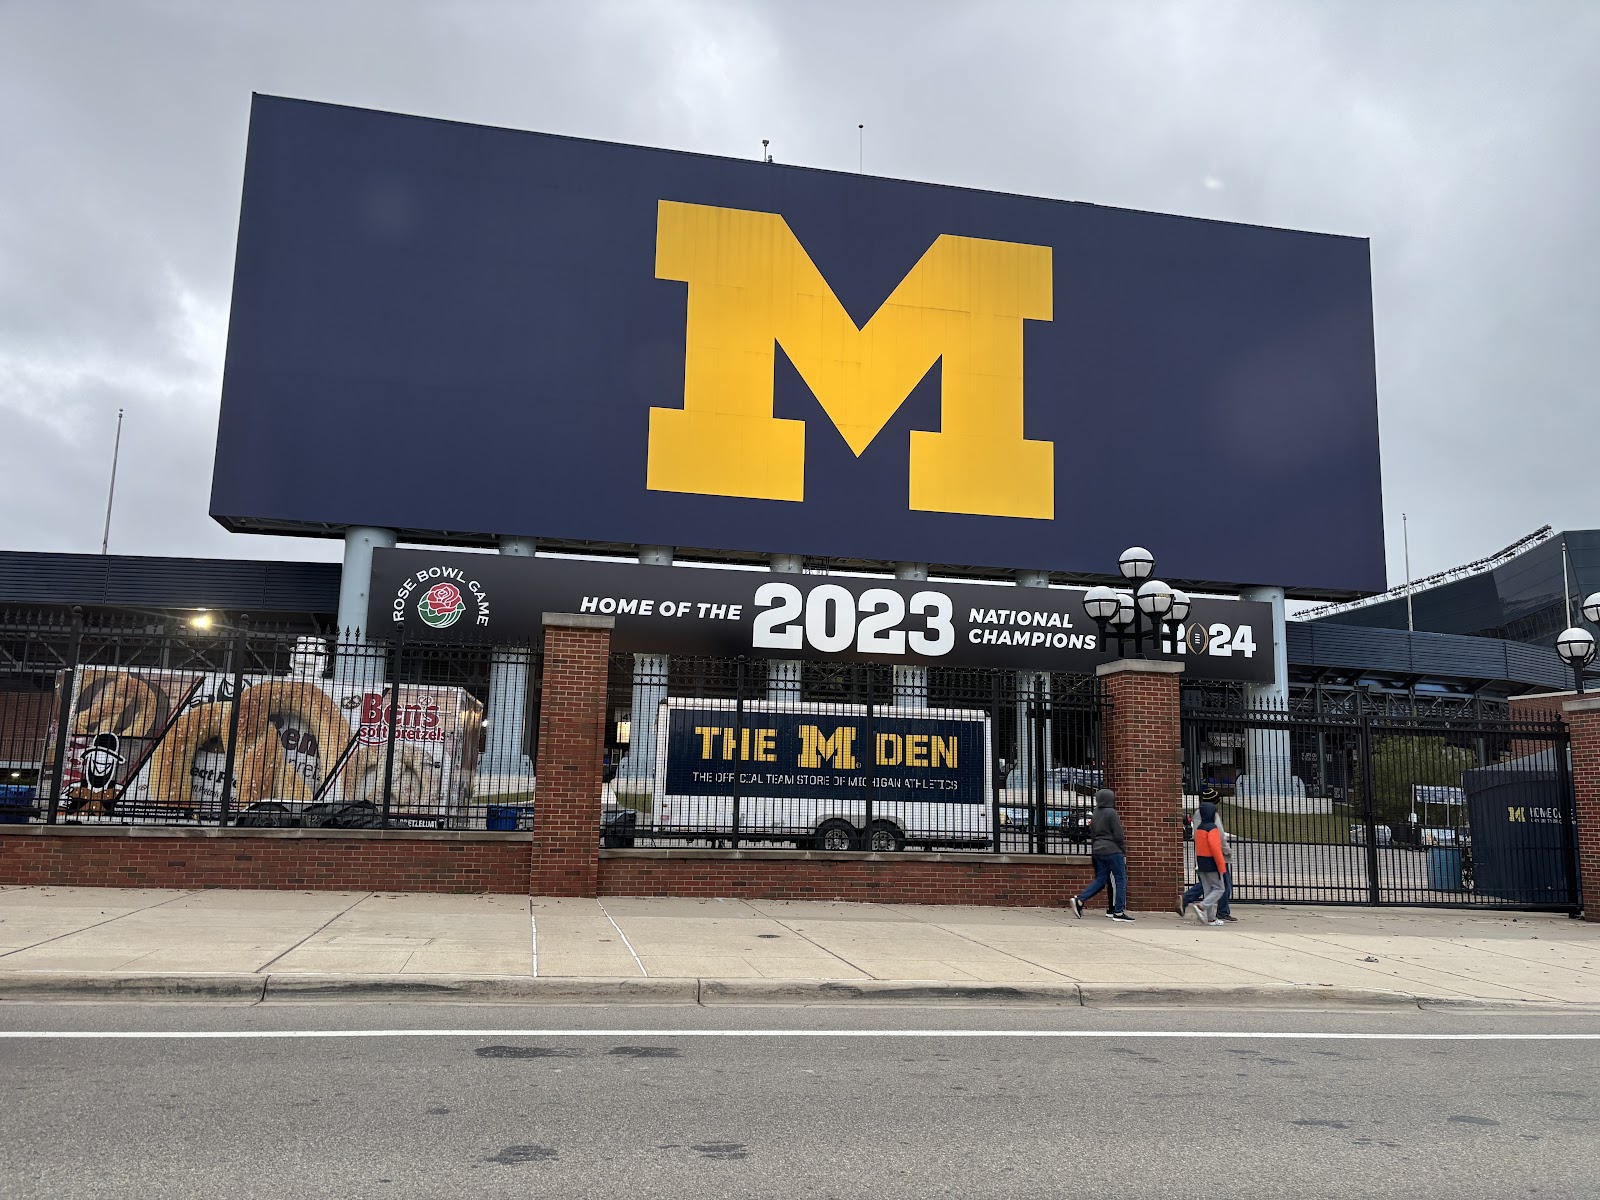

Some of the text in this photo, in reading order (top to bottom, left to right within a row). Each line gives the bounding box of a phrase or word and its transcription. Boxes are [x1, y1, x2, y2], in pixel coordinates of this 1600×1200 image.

[646, 199, 1055, 521] M
[393, 566, 490, 627] ROSE BOWL GAME
[579, 596, 743, 621] HOME OF THE
[752, 582, 956, 657] 2023
[968, 607, 1074, 629] NATIONAL
[968, 628, 1097, 650] CHAMPIONS
[360, 726, 388, 739] soft
[694, 725, 958, 769] THE M DEN
[692, 771, 712, 783] THE
[765, 773, 794, 785] TEAM
[796, 774, 829, 787] STORE
